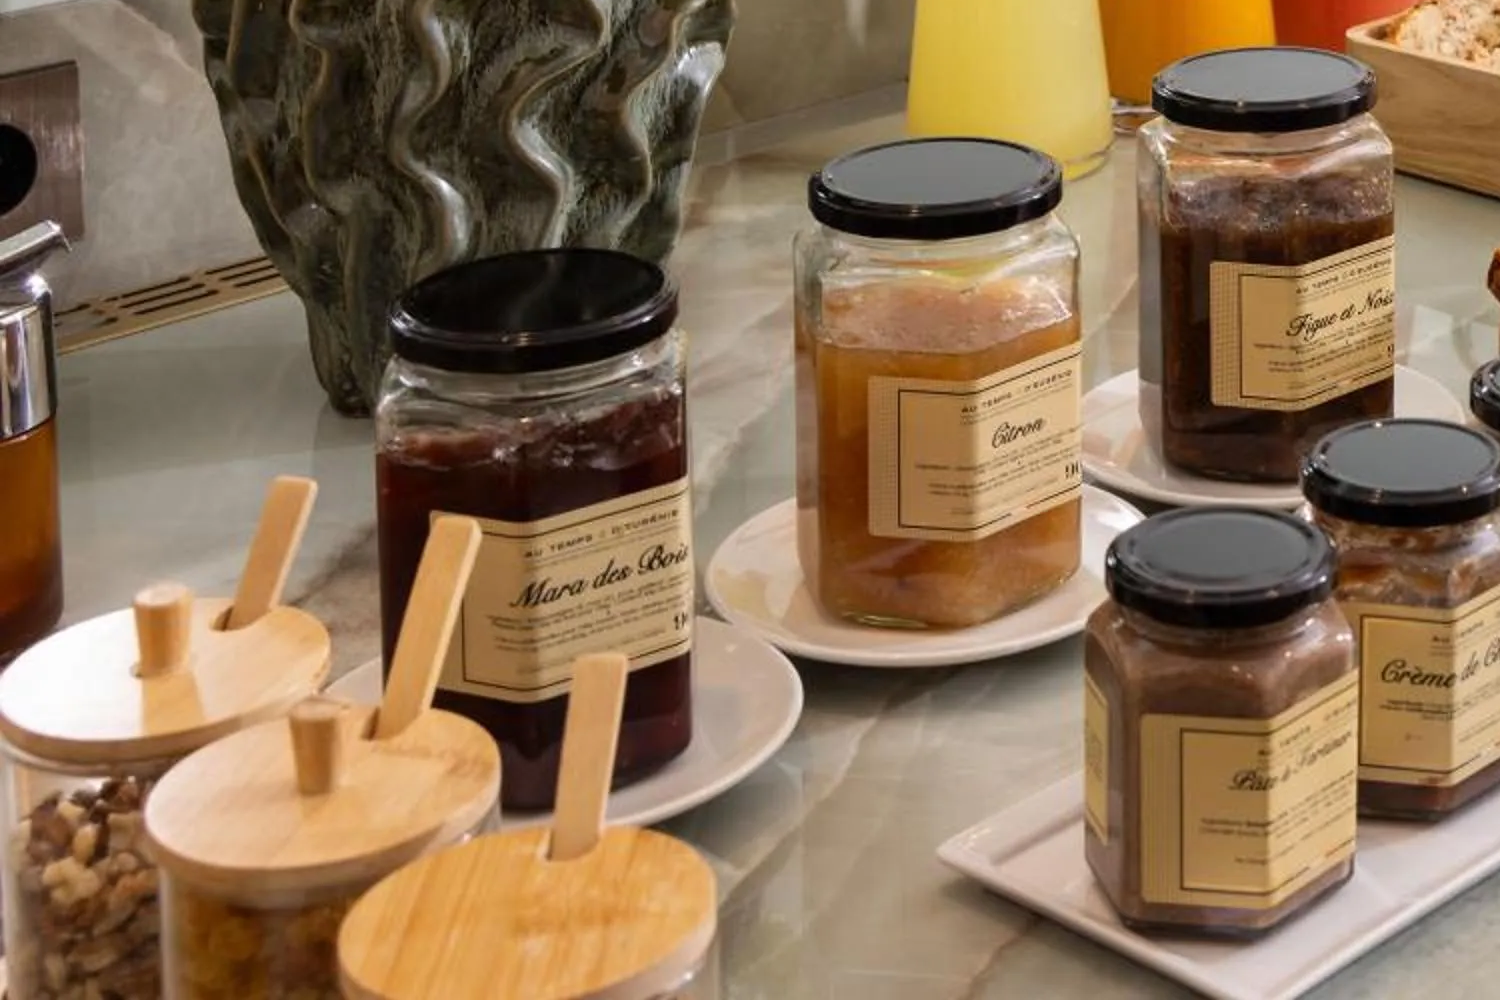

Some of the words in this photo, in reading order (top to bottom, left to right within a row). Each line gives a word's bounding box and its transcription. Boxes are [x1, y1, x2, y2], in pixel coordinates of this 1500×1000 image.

[1286, 312, 1338, 342] Figue
[1340, 303, 1356, 320] et
[991, 417, 1046, 448] Citron
[509, 579, 588, 609] Mara
[592, 558, 634, 590] des
[1380, 659, 1457, 688] Crème
